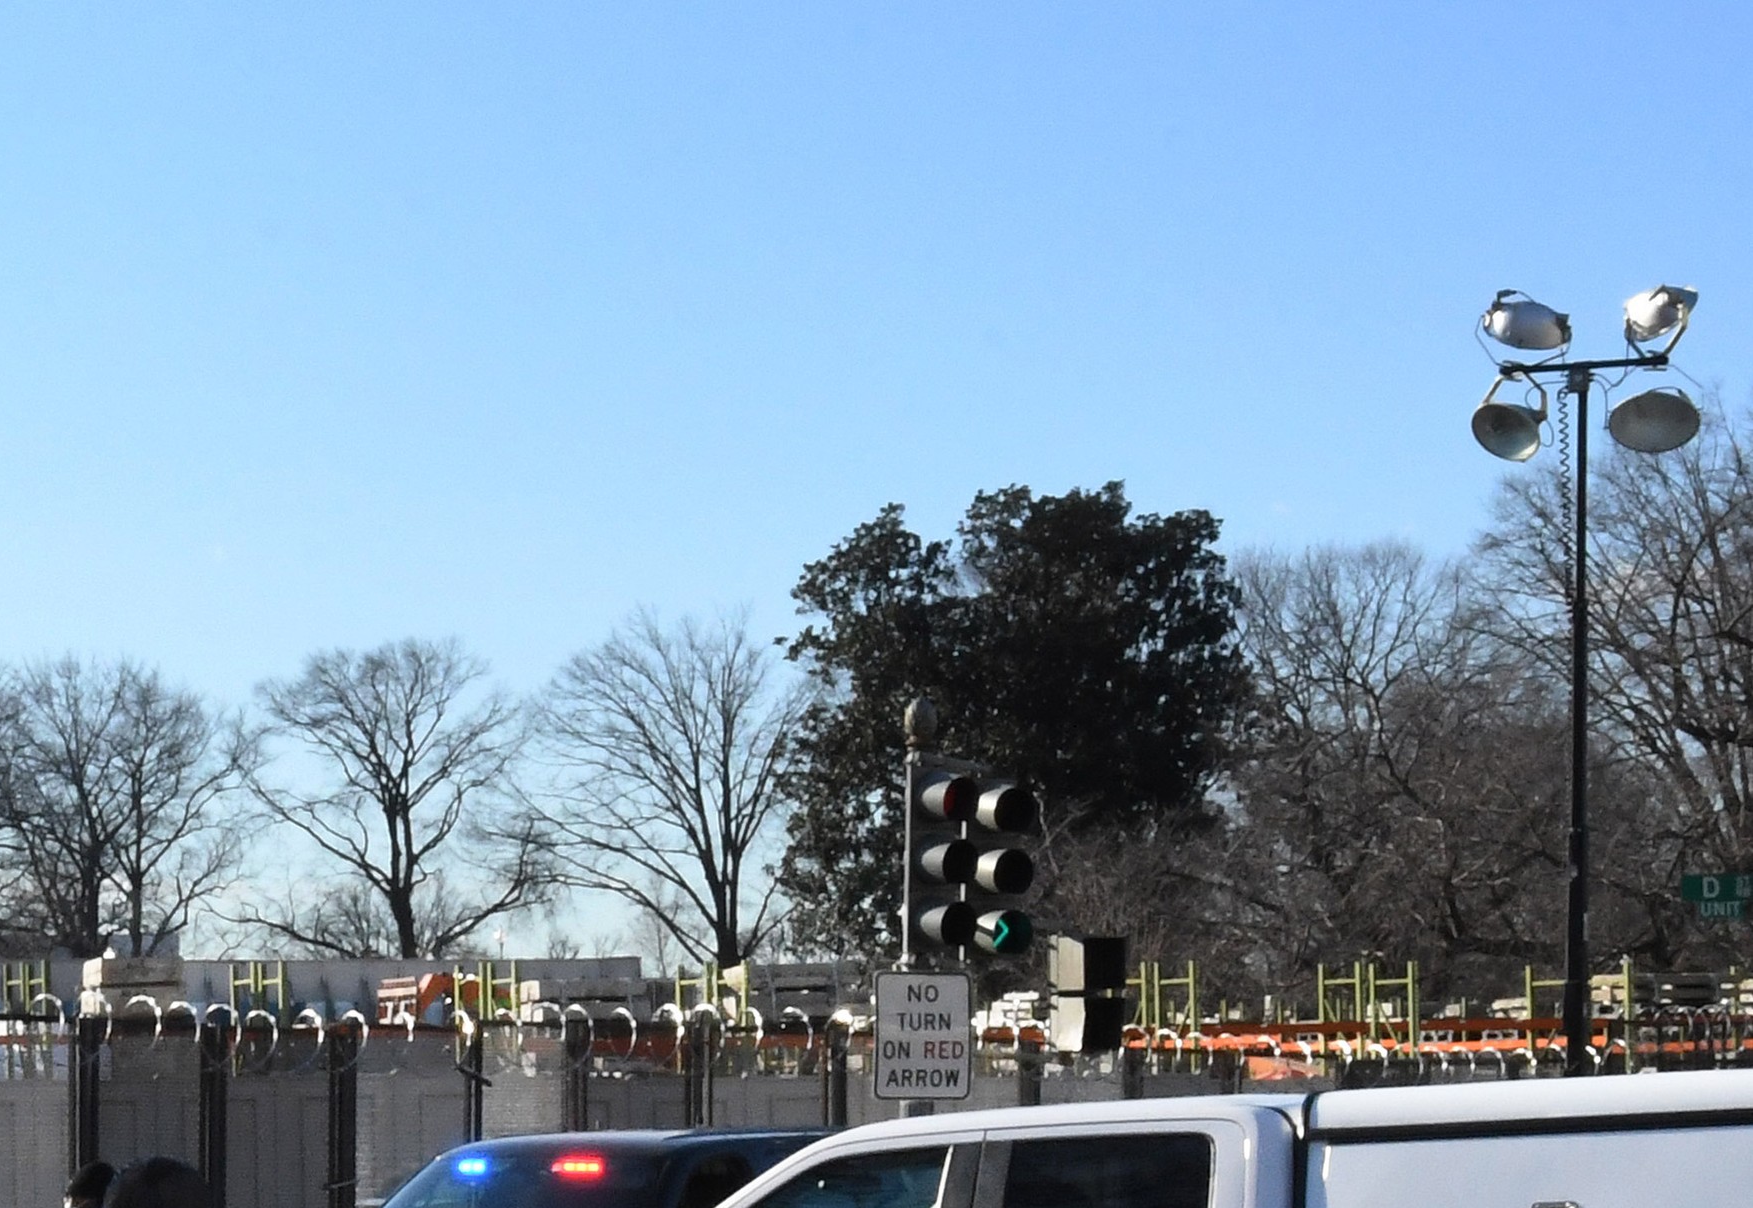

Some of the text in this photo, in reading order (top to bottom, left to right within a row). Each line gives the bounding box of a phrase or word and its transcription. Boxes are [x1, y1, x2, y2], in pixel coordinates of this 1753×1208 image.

[1702, 876, 1720, 898] D
[1700, 901, 1741, 917] UNIT
[907, 984, 939, 1003] NO
[897, 1013, 951, 1031] TURN
[883, 1040, 964, 1059] ON RED
[886, 1069, 960, 1087] ARROW
